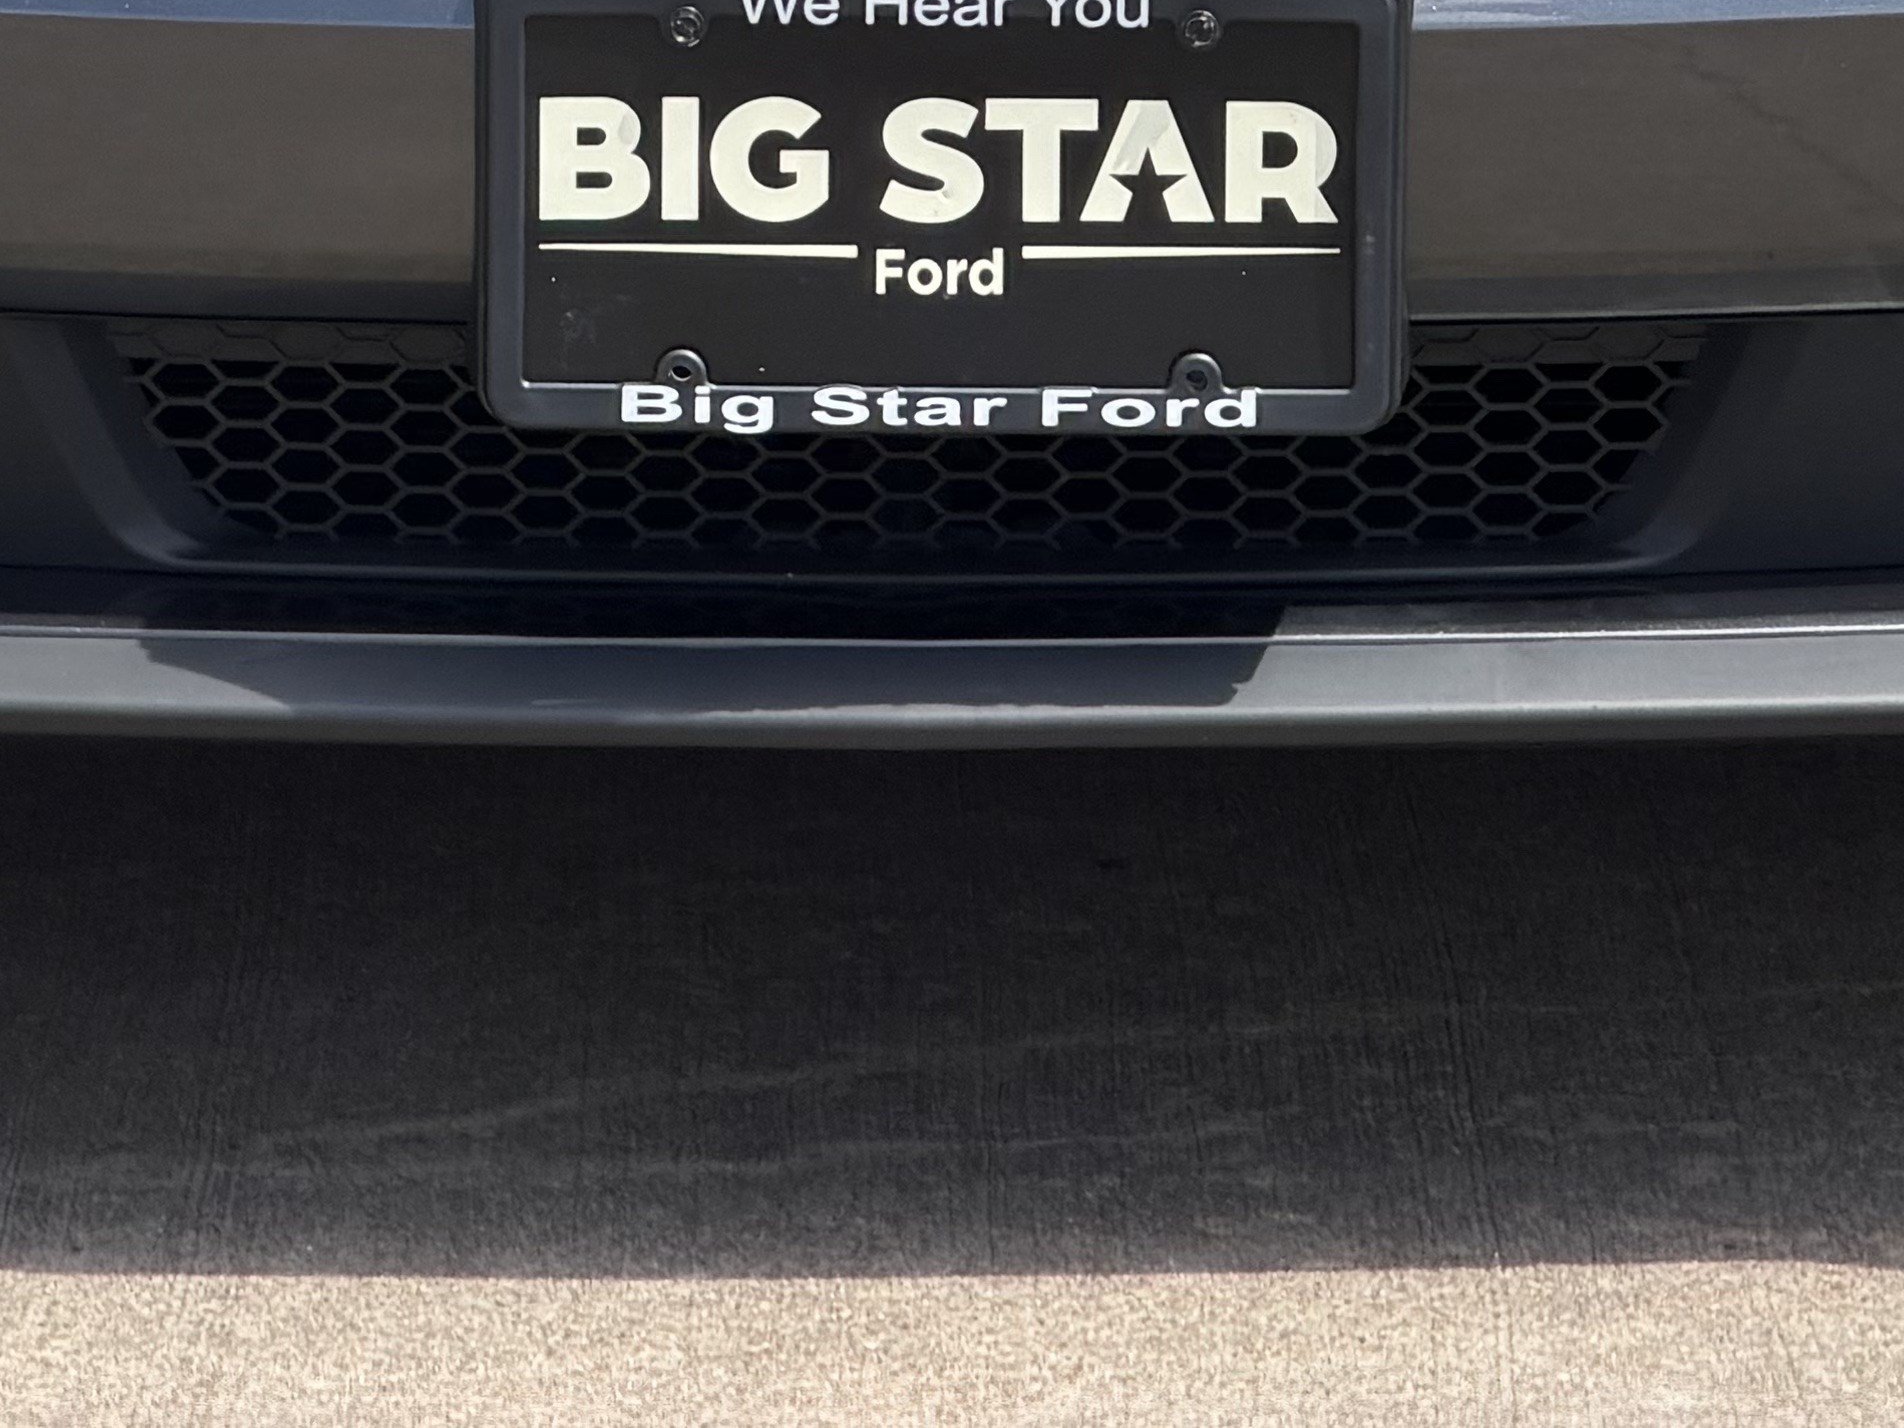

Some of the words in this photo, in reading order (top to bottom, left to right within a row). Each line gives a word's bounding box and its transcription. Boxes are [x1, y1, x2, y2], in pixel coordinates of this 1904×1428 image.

[538, 95, 831, 224] BIG
[879, 96, 1339, 225] STAR
[874, 246, 1005, 297] Ford
[619, 383, 775, 431] Big
[810, 385, 1008, 427] Star
[1040, 387, 1258, 428] Ford
